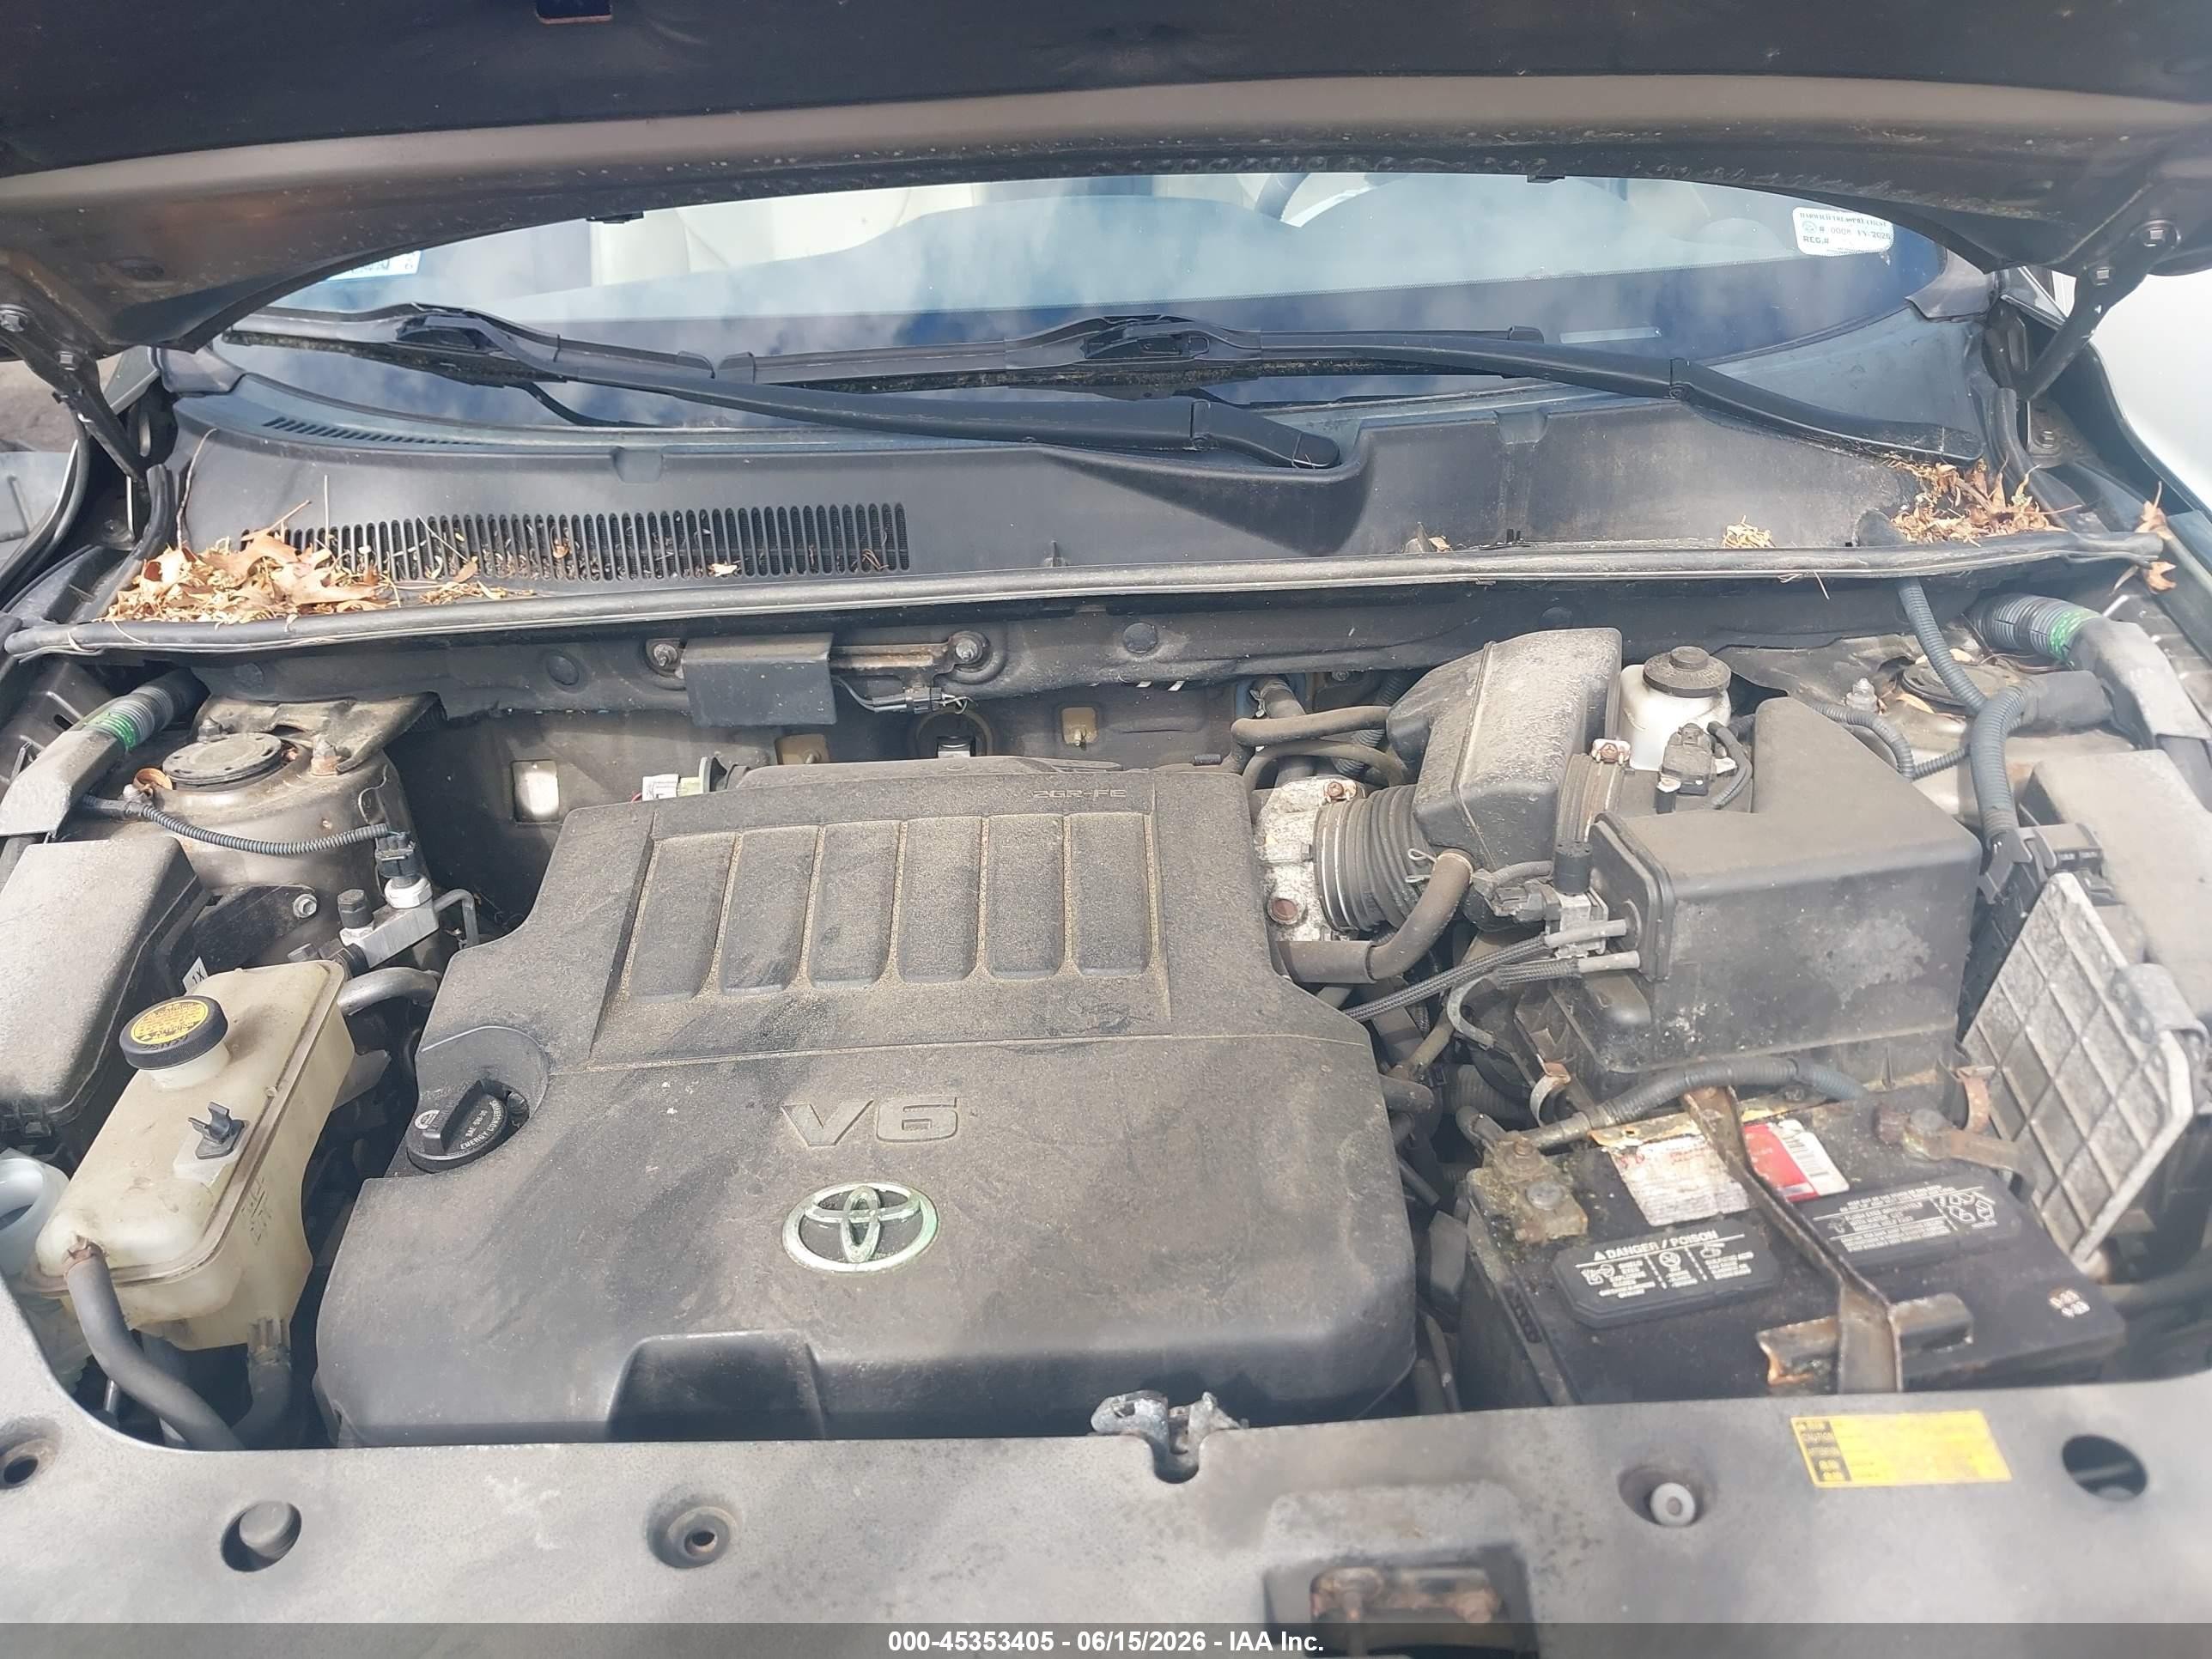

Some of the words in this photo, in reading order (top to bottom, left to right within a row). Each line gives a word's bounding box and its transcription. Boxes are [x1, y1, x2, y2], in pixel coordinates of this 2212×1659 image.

[1032, 788, 1127, 799] 2GR-FE
[781, 1097, 959, 1146] V6
[459, 1130, 489, 1150] ENERGY
[1605, 1239, 1660, 1261] DANGER
[1670, 1230, 1719, 1247] POISON
